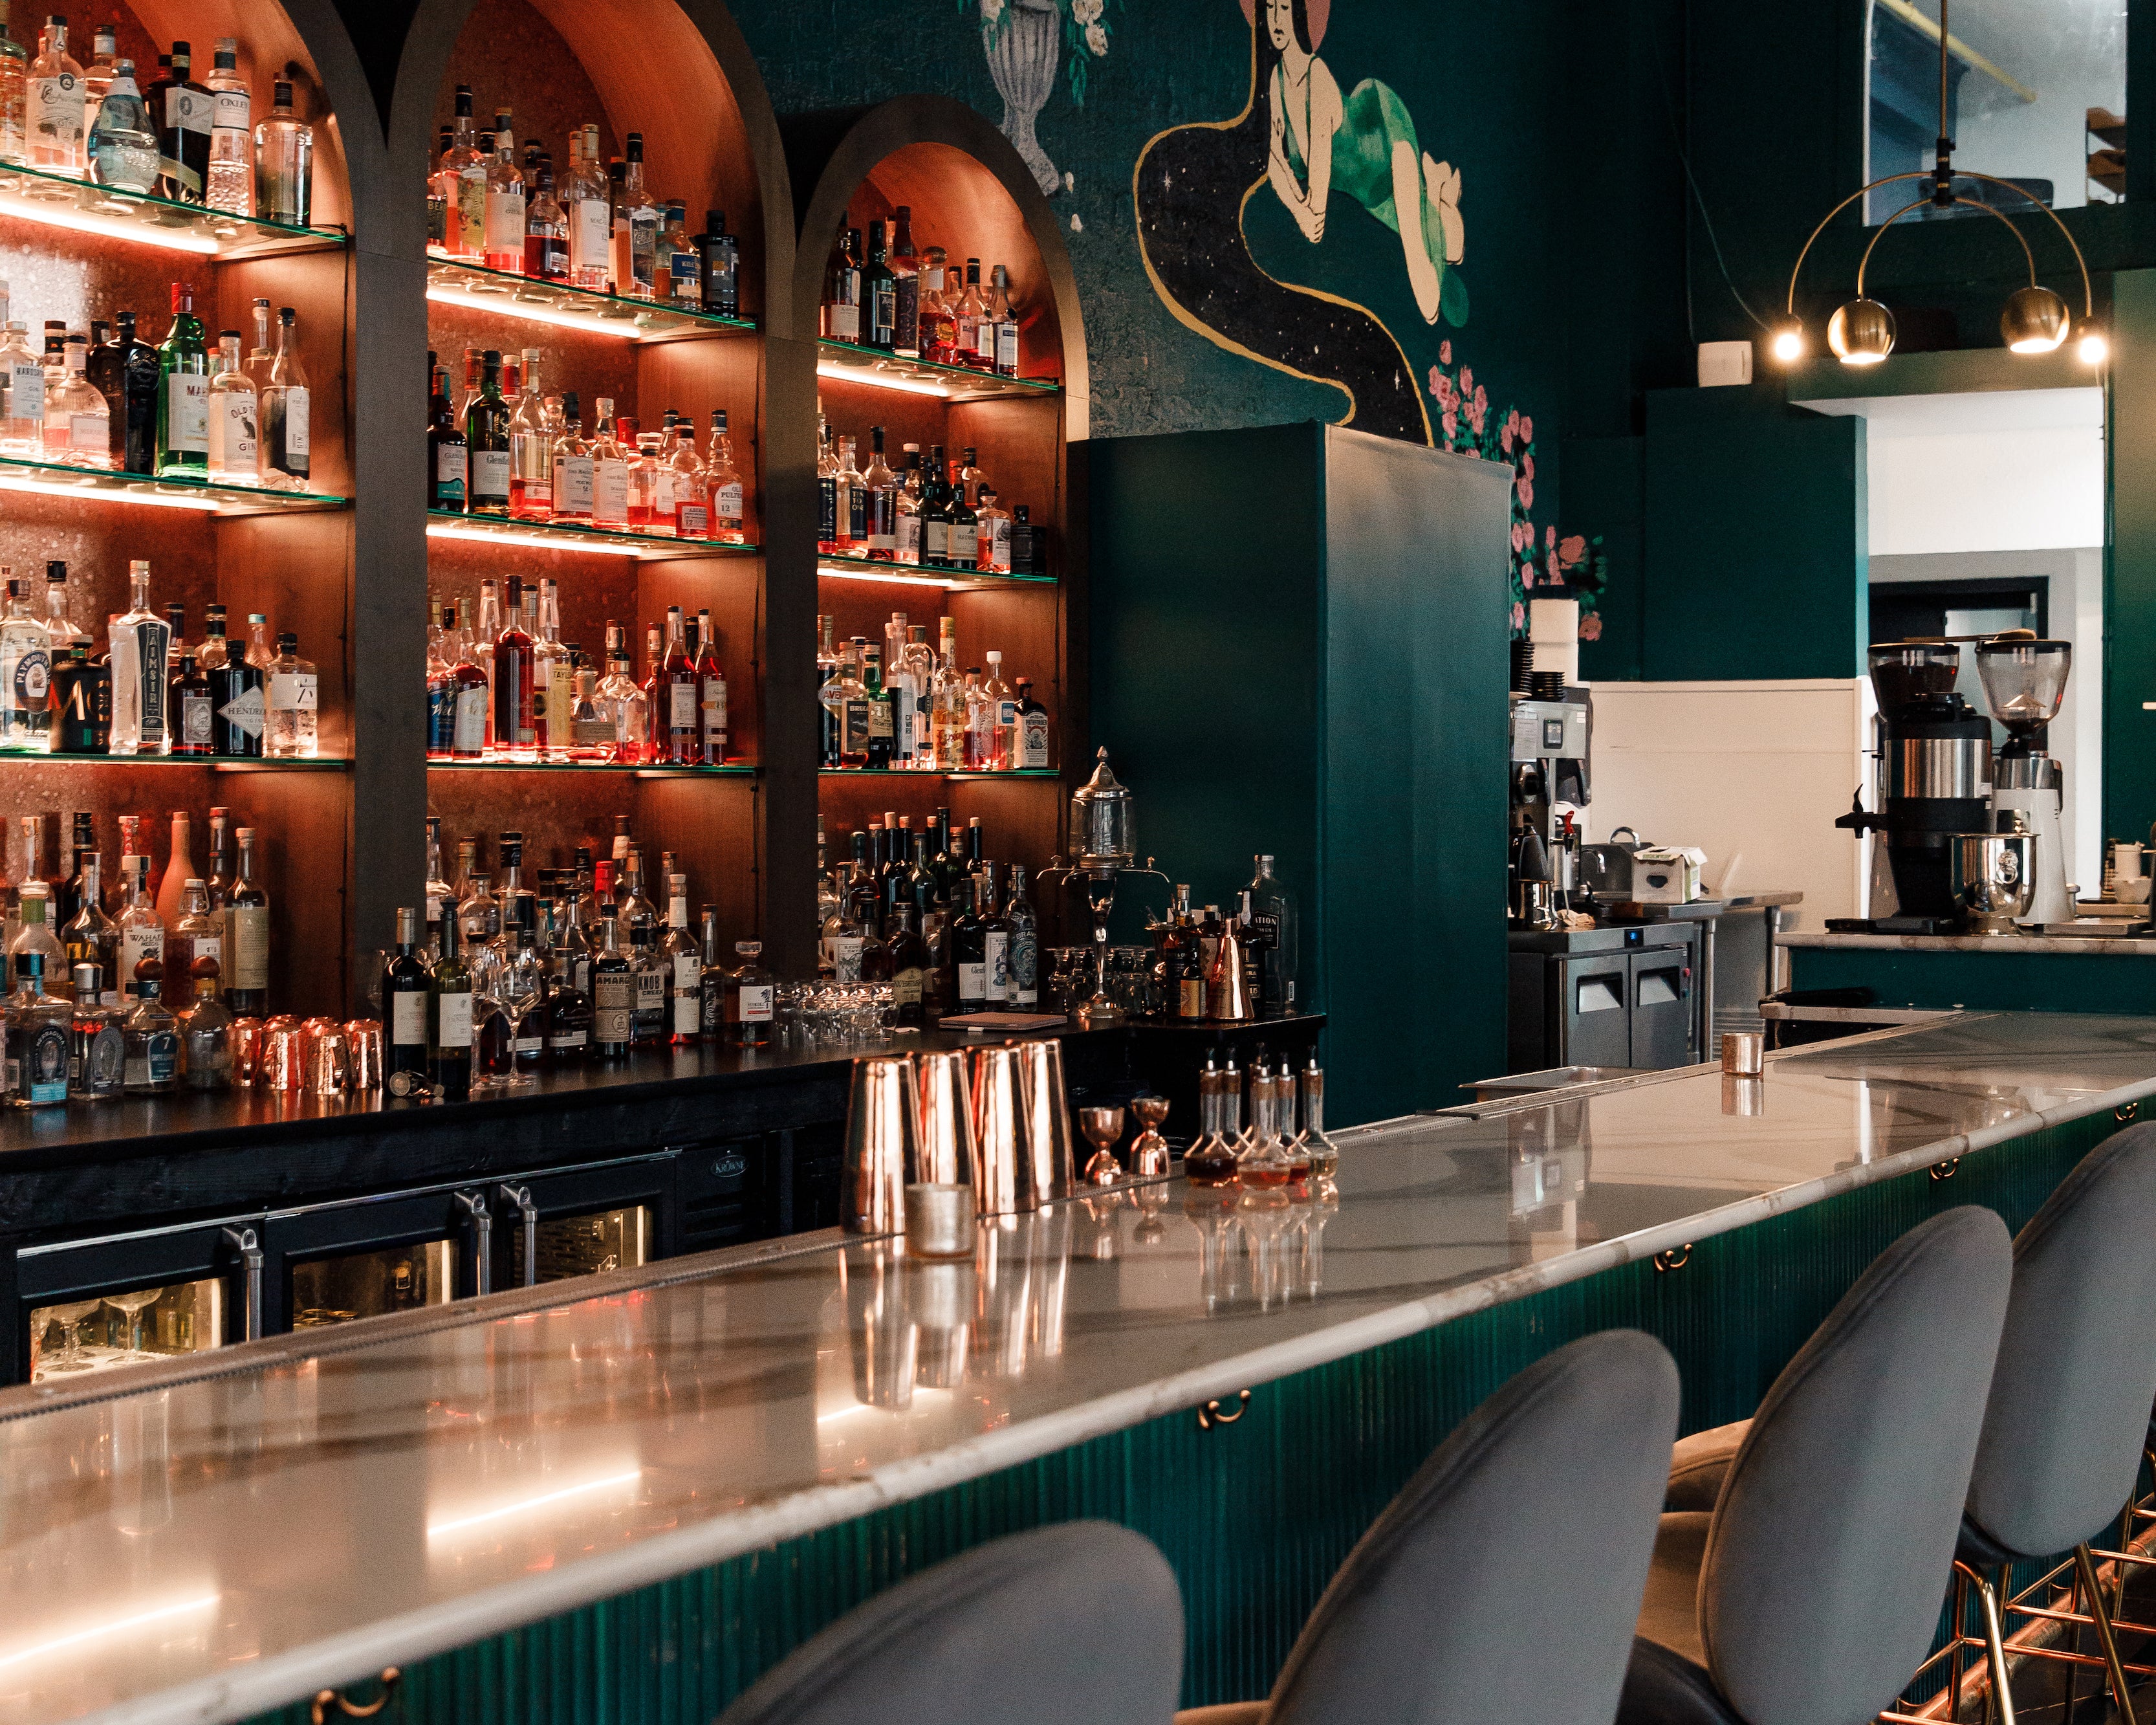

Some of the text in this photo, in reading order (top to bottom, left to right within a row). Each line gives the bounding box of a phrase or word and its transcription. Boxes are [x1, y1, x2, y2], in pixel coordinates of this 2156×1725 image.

[230, 406, 247, 418] OLD
[239, 443, 256, 451] GIN
[638, 975, 660, 990] KNOB
[162, 1037, 171, 1050] 7
